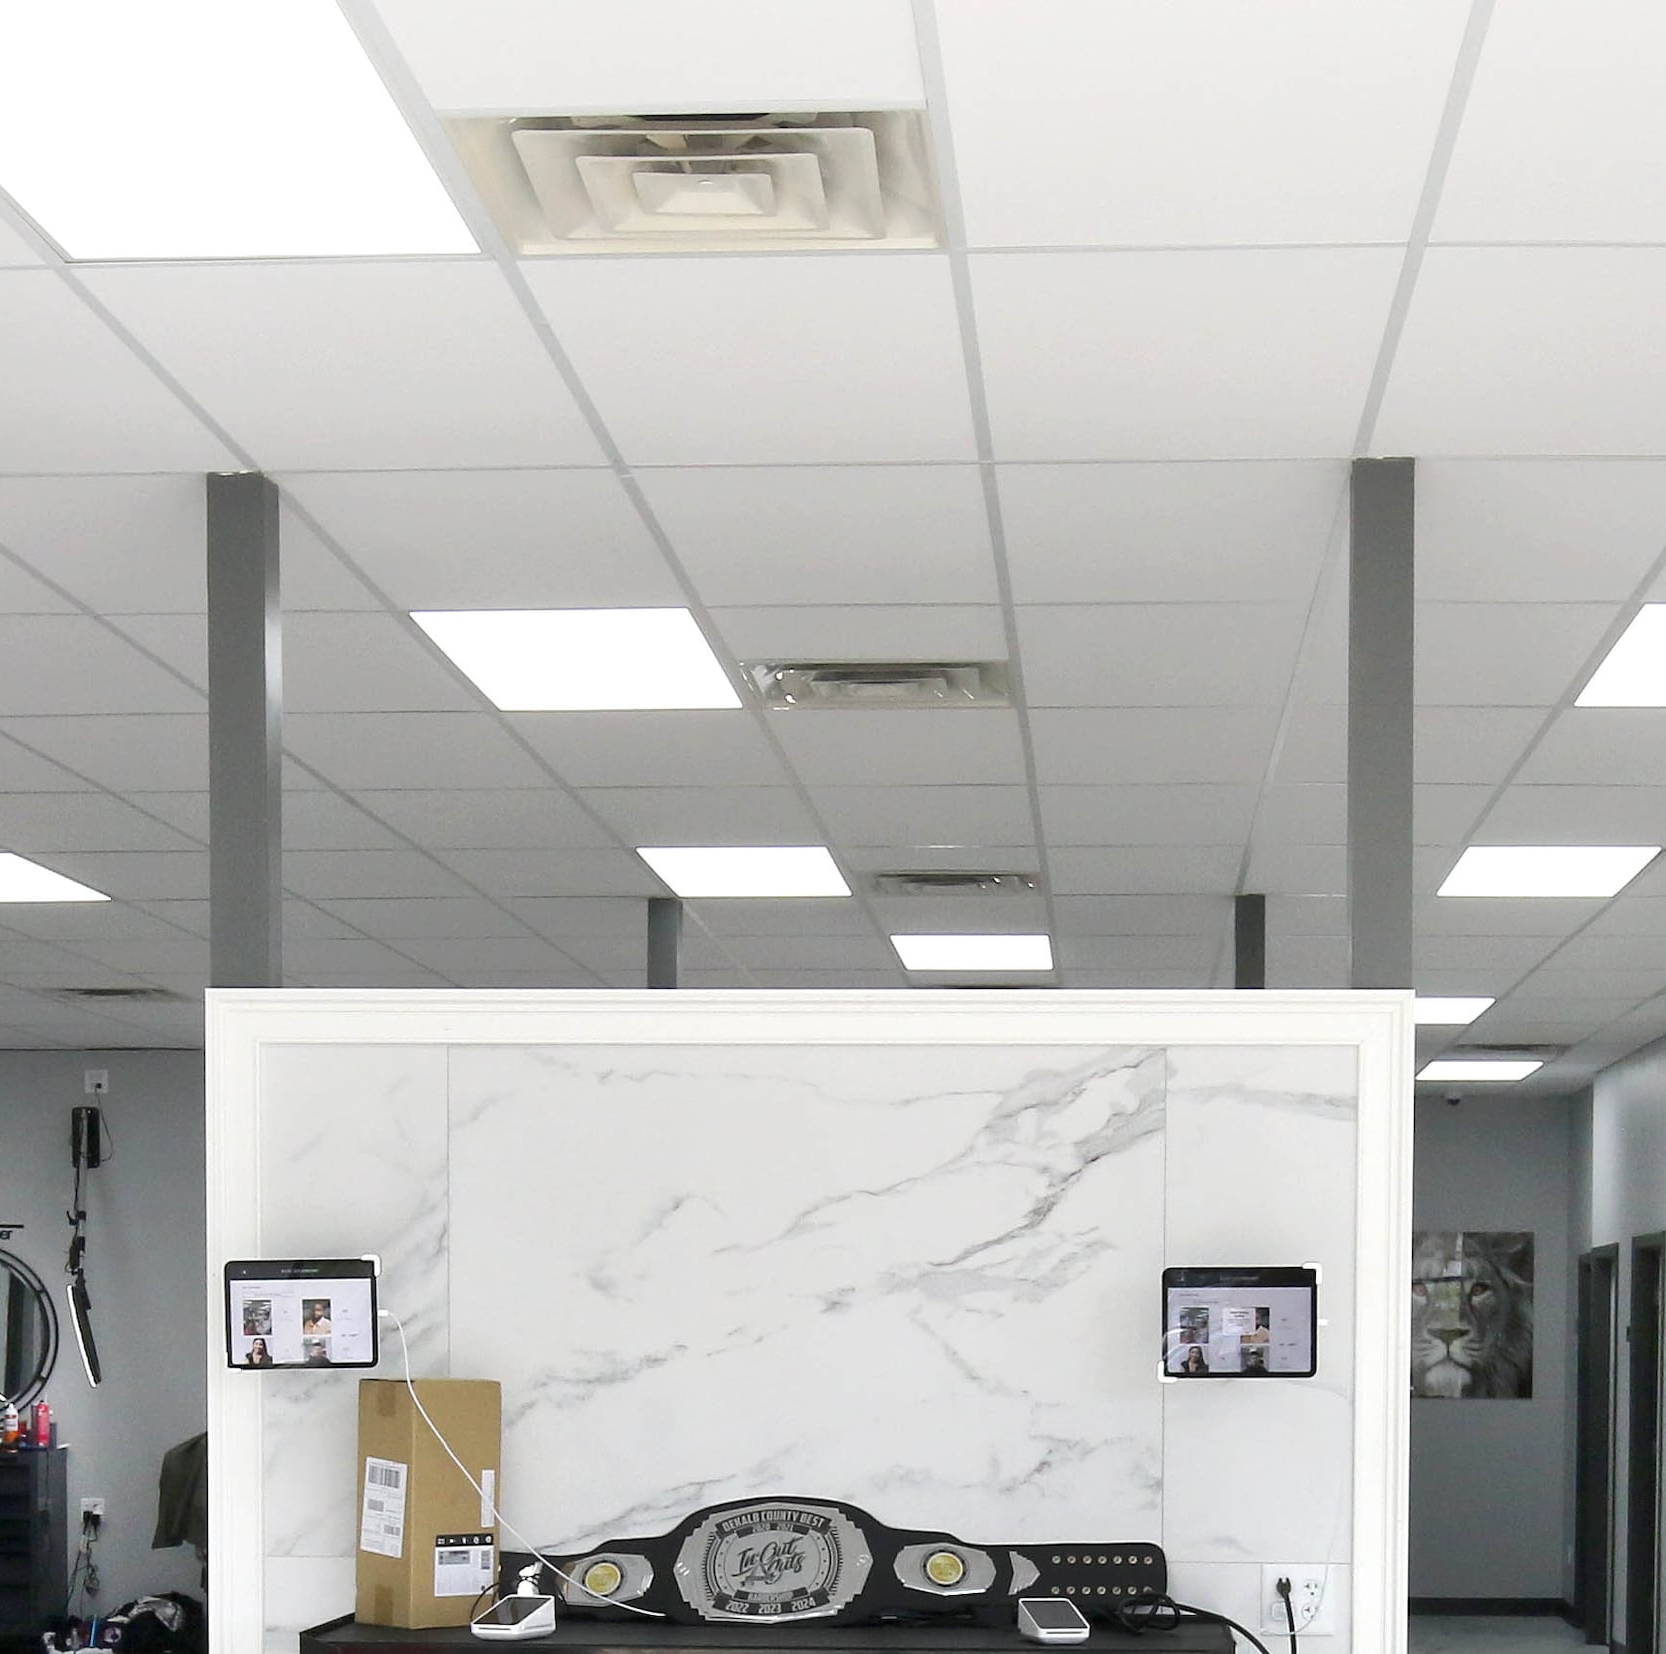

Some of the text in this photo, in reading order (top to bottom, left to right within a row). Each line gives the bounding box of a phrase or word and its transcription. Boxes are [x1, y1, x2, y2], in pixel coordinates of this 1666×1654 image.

[722, 1509, 826, 1532] DEKALB COUNTY BEST
[725, 1597, 816, 1614] 2022 2023 2024
